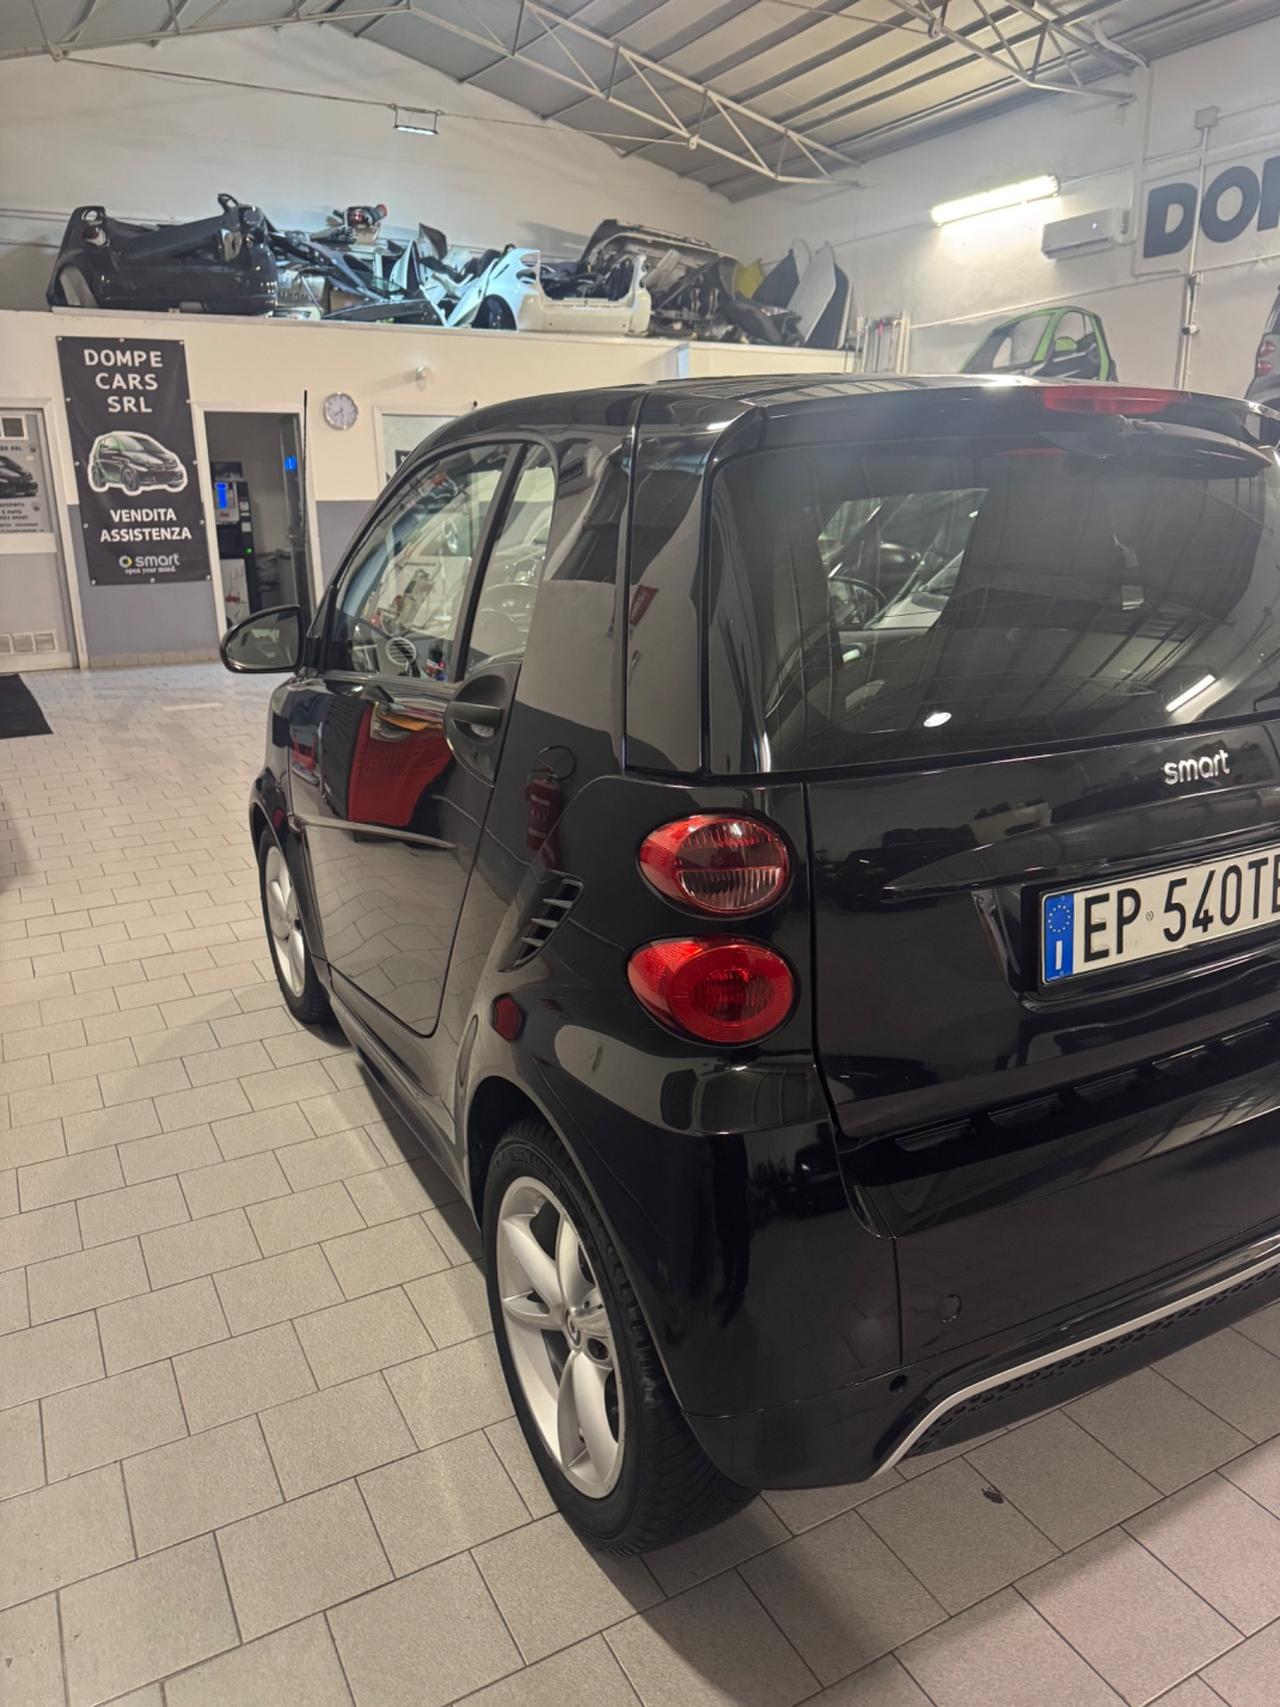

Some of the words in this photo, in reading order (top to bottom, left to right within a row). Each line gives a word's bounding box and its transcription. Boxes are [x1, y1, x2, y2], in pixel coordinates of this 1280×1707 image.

[83, 349, 163, 367] DOMPE
[95, 372, 158, 390] CARS
[107, 396, 152, 413] SRL
[110, 508, 177, 522] VENDITA
[100, 527, 192, 542] ASSISTENZA
[135, 553, 180, 567] smart
[1164, 749, 1230, 785] smart
[1084, 888, 1143, 963] EP
